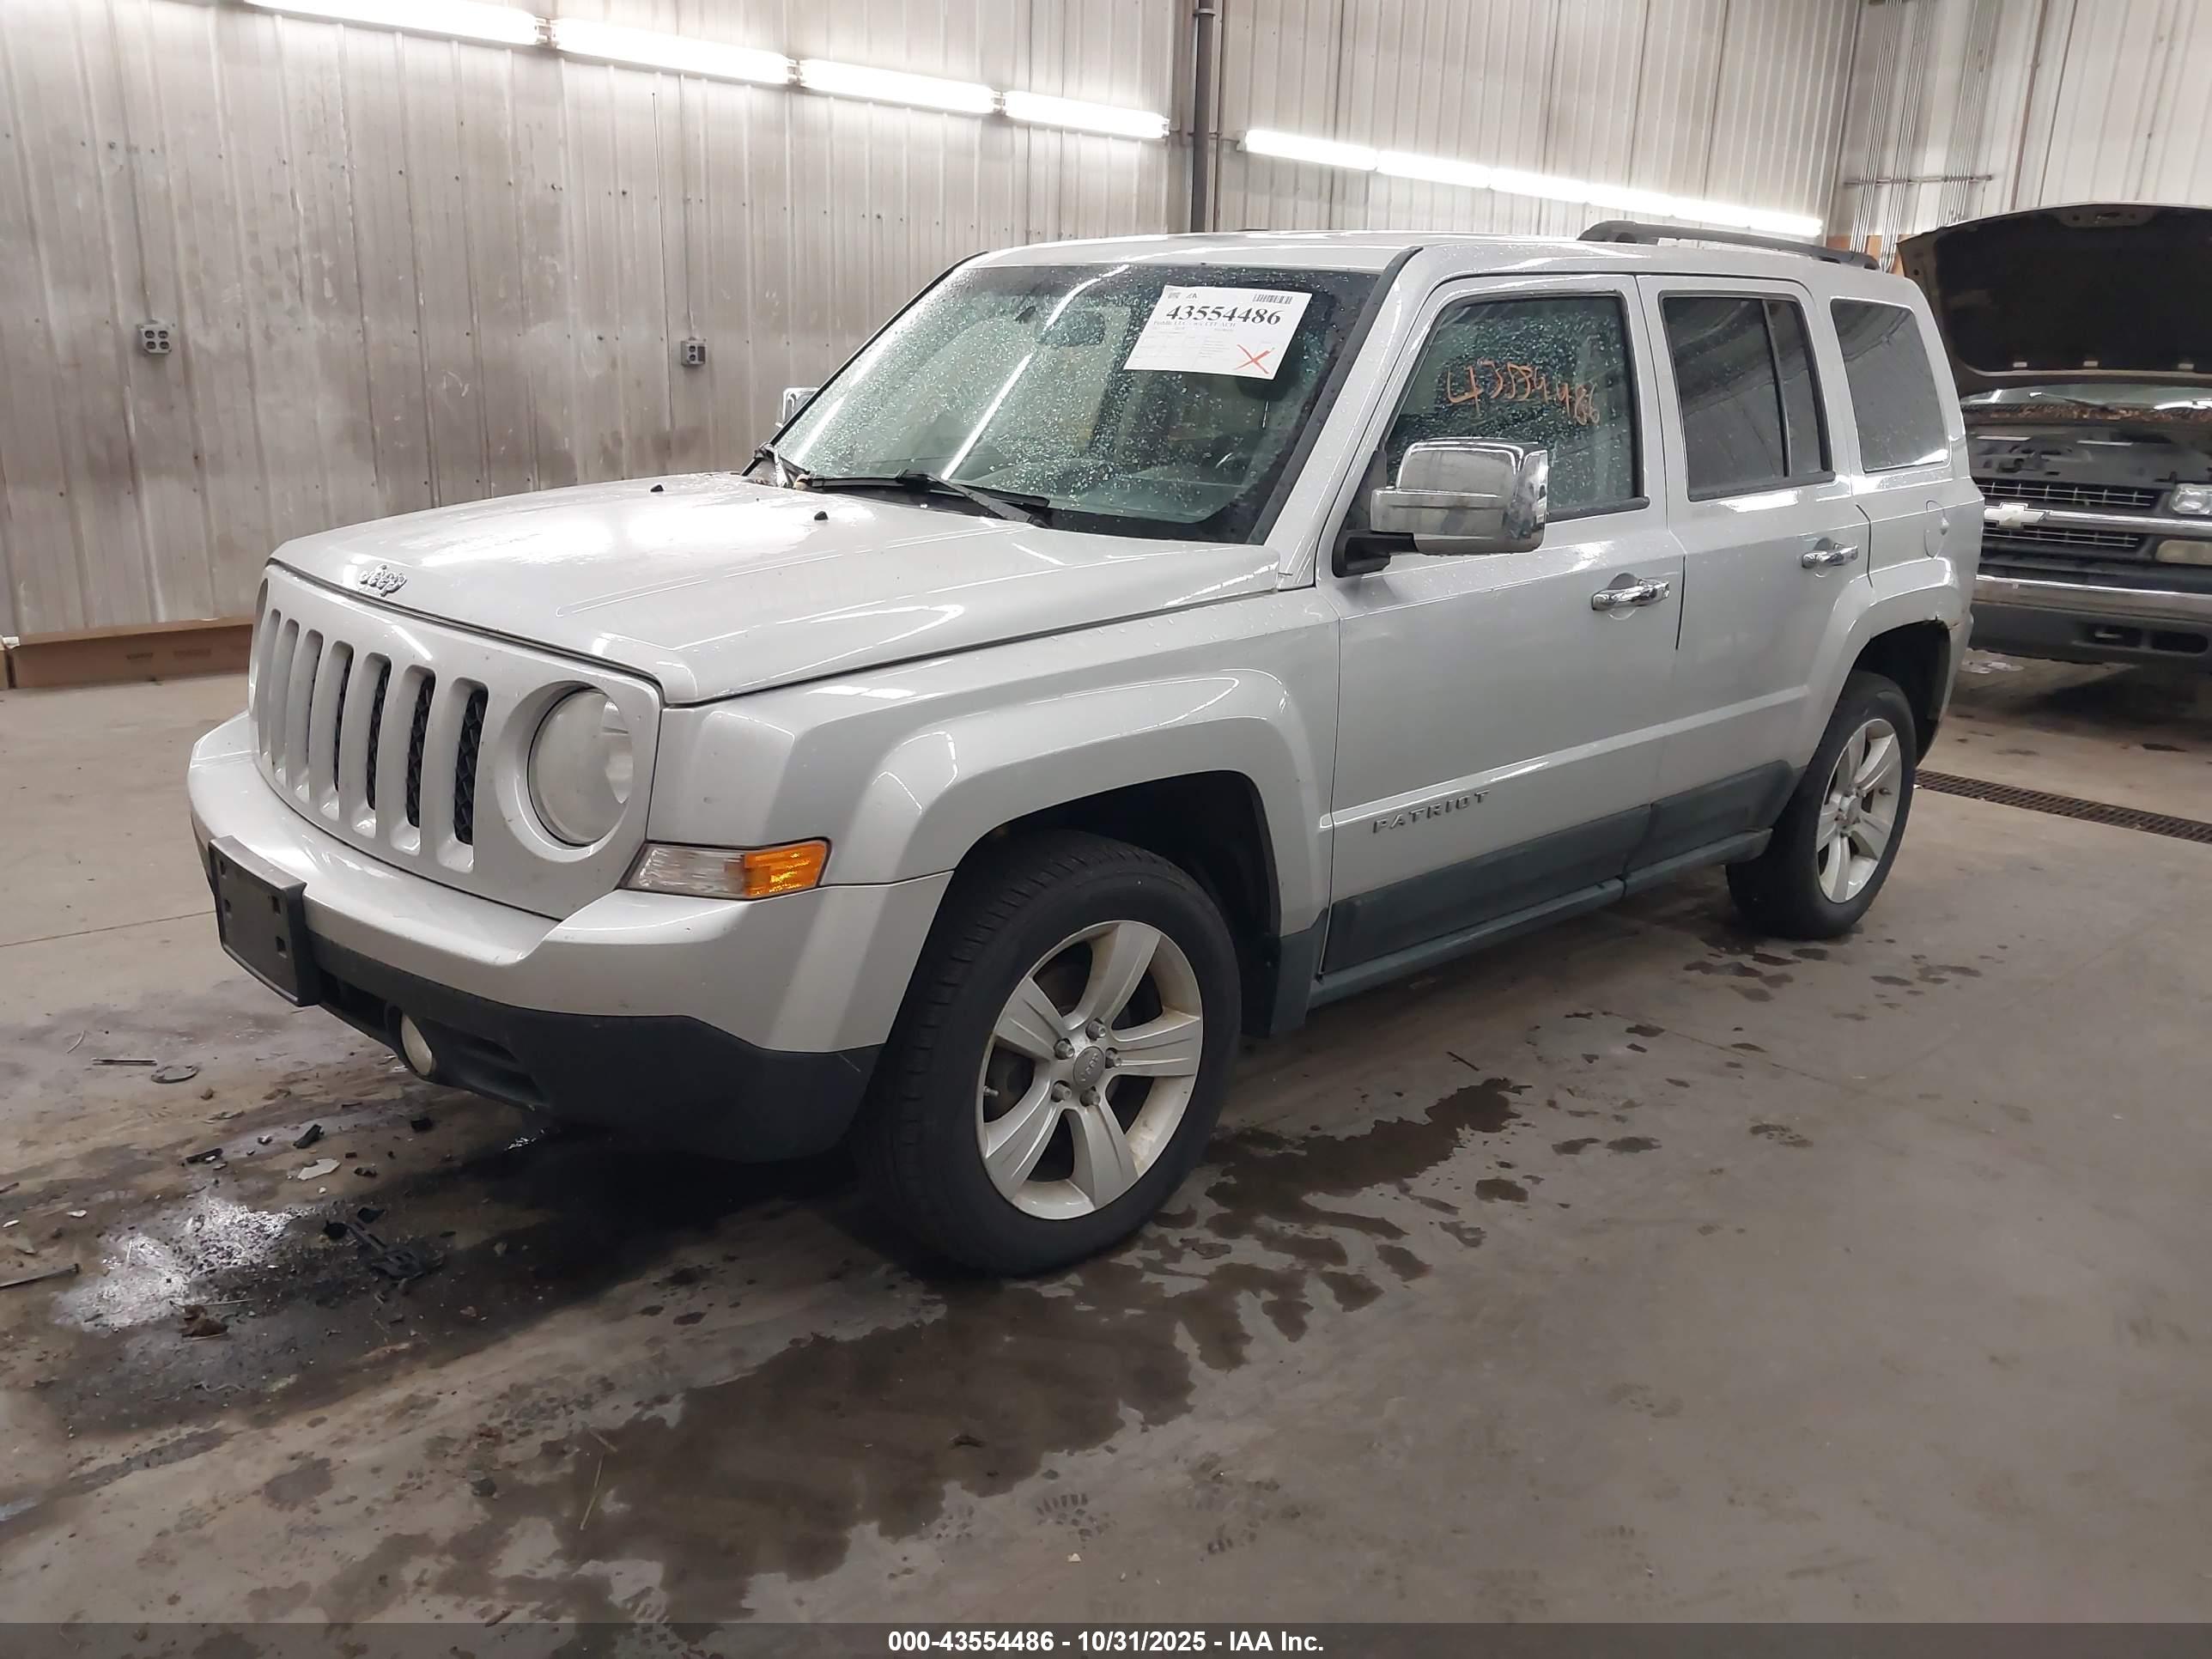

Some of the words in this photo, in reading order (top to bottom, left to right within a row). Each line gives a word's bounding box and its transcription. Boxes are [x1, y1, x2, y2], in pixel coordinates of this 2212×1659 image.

[1166, 305, 1285, 325] 43554486
[359, 564, 408, 597] Jeep
[1372, 789, 1491, 834] PATRIOT
